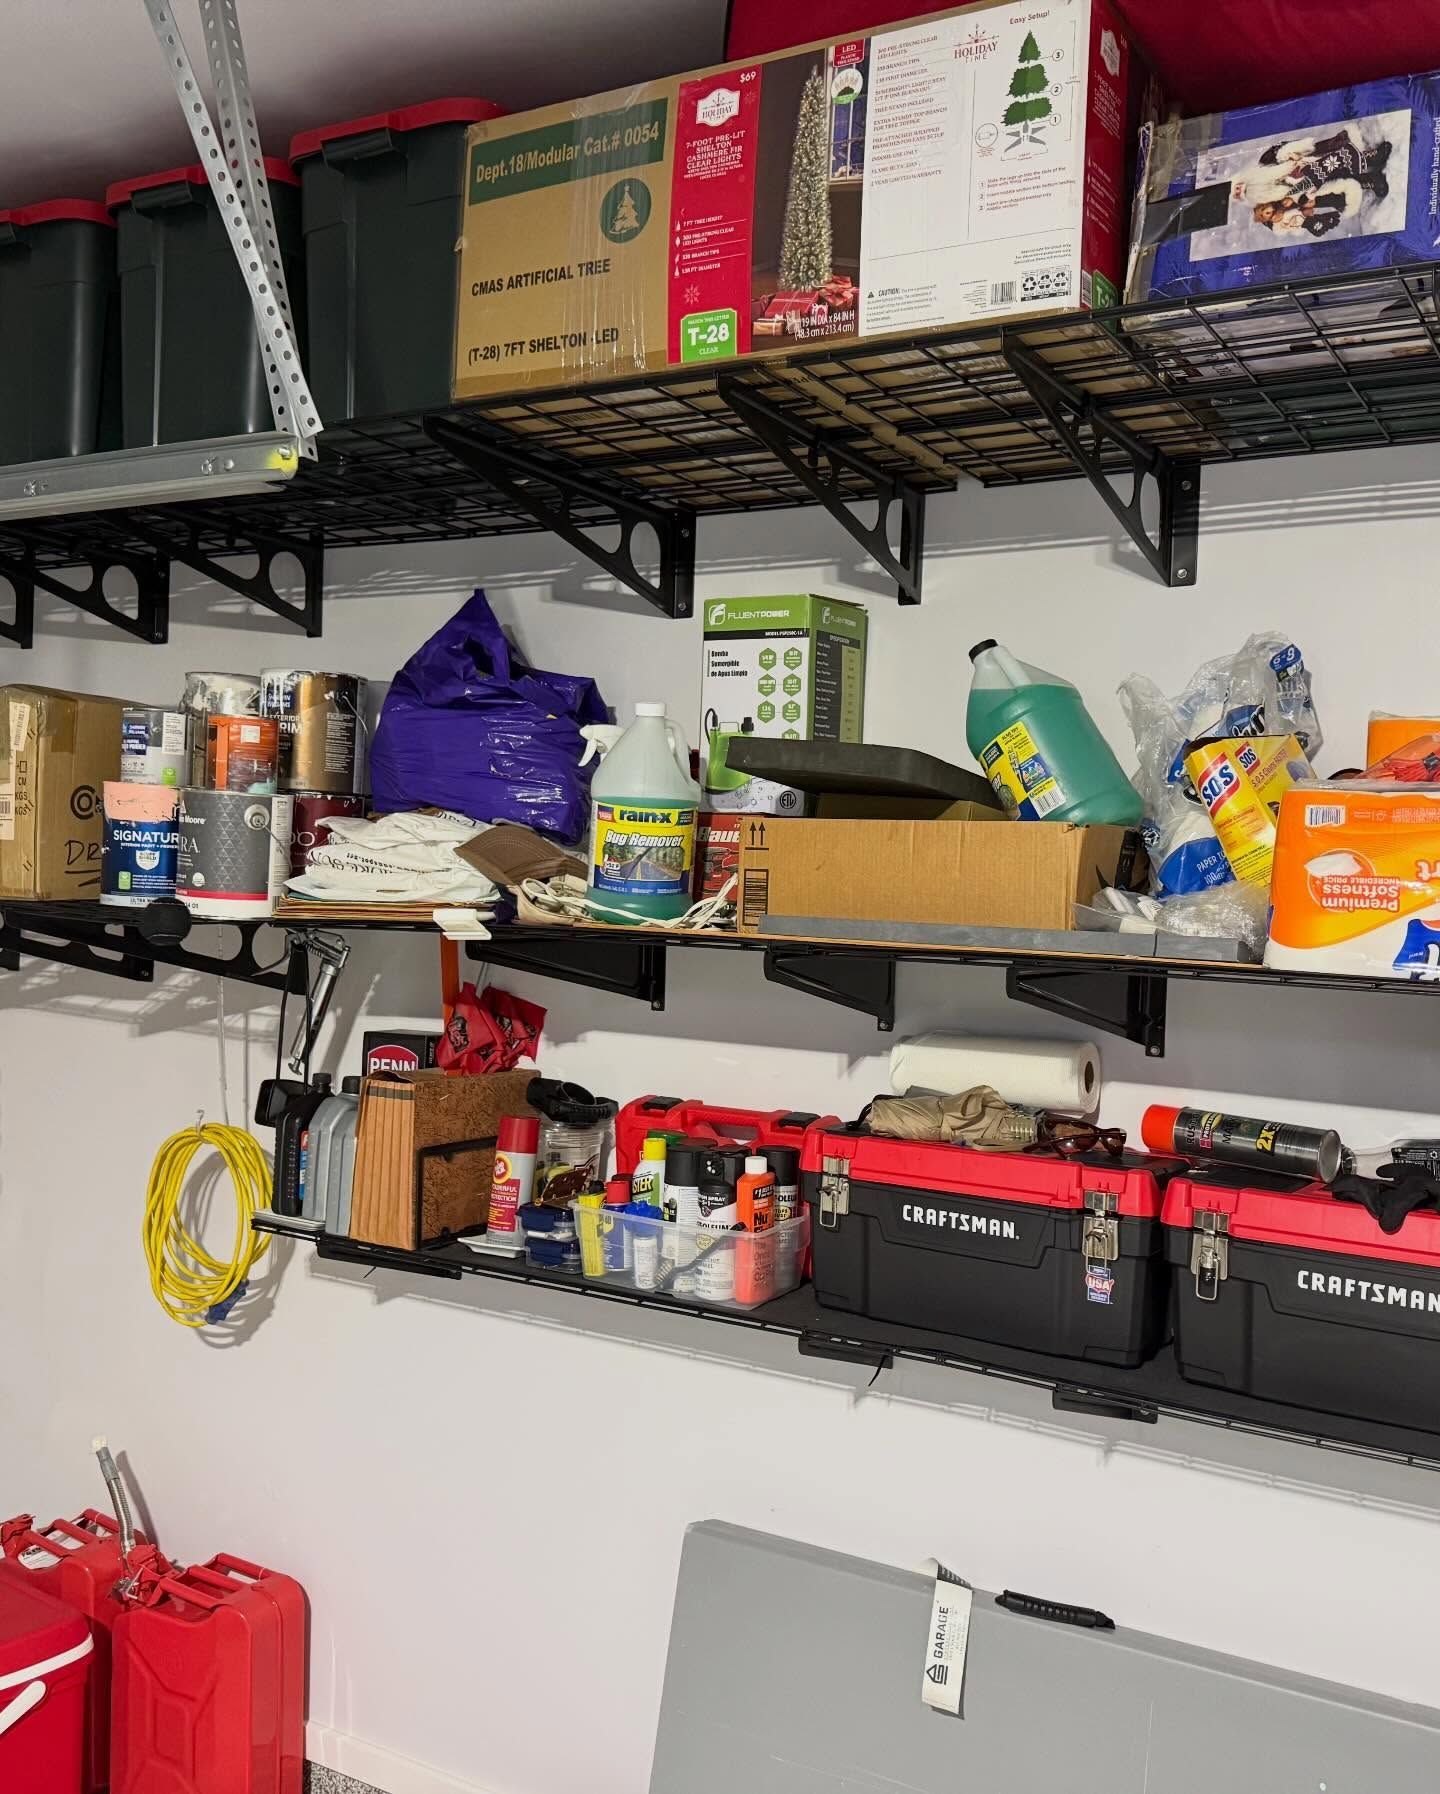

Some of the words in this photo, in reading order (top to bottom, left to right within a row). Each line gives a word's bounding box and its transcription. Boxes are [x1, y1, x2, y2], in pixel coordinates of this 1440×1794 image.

[1010, 16, 1026, 25] Easy
[1028, 10, 1050, 22] Setup!
[842, 44, 857, 53] LED
[954, 41, 998, 59] HOLIDAY
[965, 53, 988, 64] TIME
[740, 71, 757, 84] $69
[583, 130, 620, 157] Cat.#
[624, 120, 660, 148] 0054
[686, 137, 714, 149] 7-FOOT
[716, 130, 746, 142] PRE-LIT
[686, 148, 728, 163] CASHMERE
[730, 145, 743, 154] FIR
[696, 140, 732, 154] SHELTON
[686, 158, 712, 170] CLEAR
[714, 153, 742, 164] LIGHTS
[472, 277, 504, 296] CMAS
[506, 266, 574, 291] ARTIFICIAL
[577, 258, 611, 277] TREE
[802, 317, 810, 326] 19
[833, 312, 841, 322] 84
[850, 310, 855, 320] H
[688, 322, 729, 346] T-28
[810, 328, 820, 337] cm
[825, 324, 842, 336] 213.4
[842, 322, 854, 334] cm)
[468, 344, 500, 366] (T-28)
[504, 342, 526, 358] 7FT
[528, 332, 586, 354] SHELTON
[698, 346, 718, 354] CLEAR
[728, 610, 790, 620] FLUENTPOWER
[711, 650, 728, 658] Bomba
[718, 670, 730, 678] Agua
[730, 670, 748, 678] Limpia
[280, 722, 304, 734] RIM
[1002, 732, 1011, 740] ALSO
[1263, 761, 1276, 776] Cleans
[18, 777, 27, 786] CM
[14, 792, 28, 800] KGS
[14, 806, 27, 816] KGS
[186, 816, 204, 824] Moore
[114, 830, 179, 844] SIGNATUR
[180, 836, 198, 853] RA
[606, 830, 629, 846] Bug
[629, 833, 684, 848] Remover
[64, 839, 100, 865] DR
[1196, 856, 1218, 873] PAPER
[1217, 852, 1226, 860] TO
[1204, 872, 1216, 885] 100
[1350, 876, 1399, 884] INCREDIBLE
[1322, 884, 1399, 898] Softness
[1322, 897, 1398, 912] Premium
[370, 1057, 416, 1075] PENN
[1256, 1128, 1274, 1152] 2X
[492, 1184, 517, 1192] OWERFUL
[632, 1178, 652, 1194] STER
[774, 1194, 796, 1202] OLEU
[697, 1221, 731, 1230] OLEUM
[754, 1211, 768, 1227] Nu
[1088, 1276, 1110, 1292] USA
[934, 1606, 949, 1658] GARAGE
